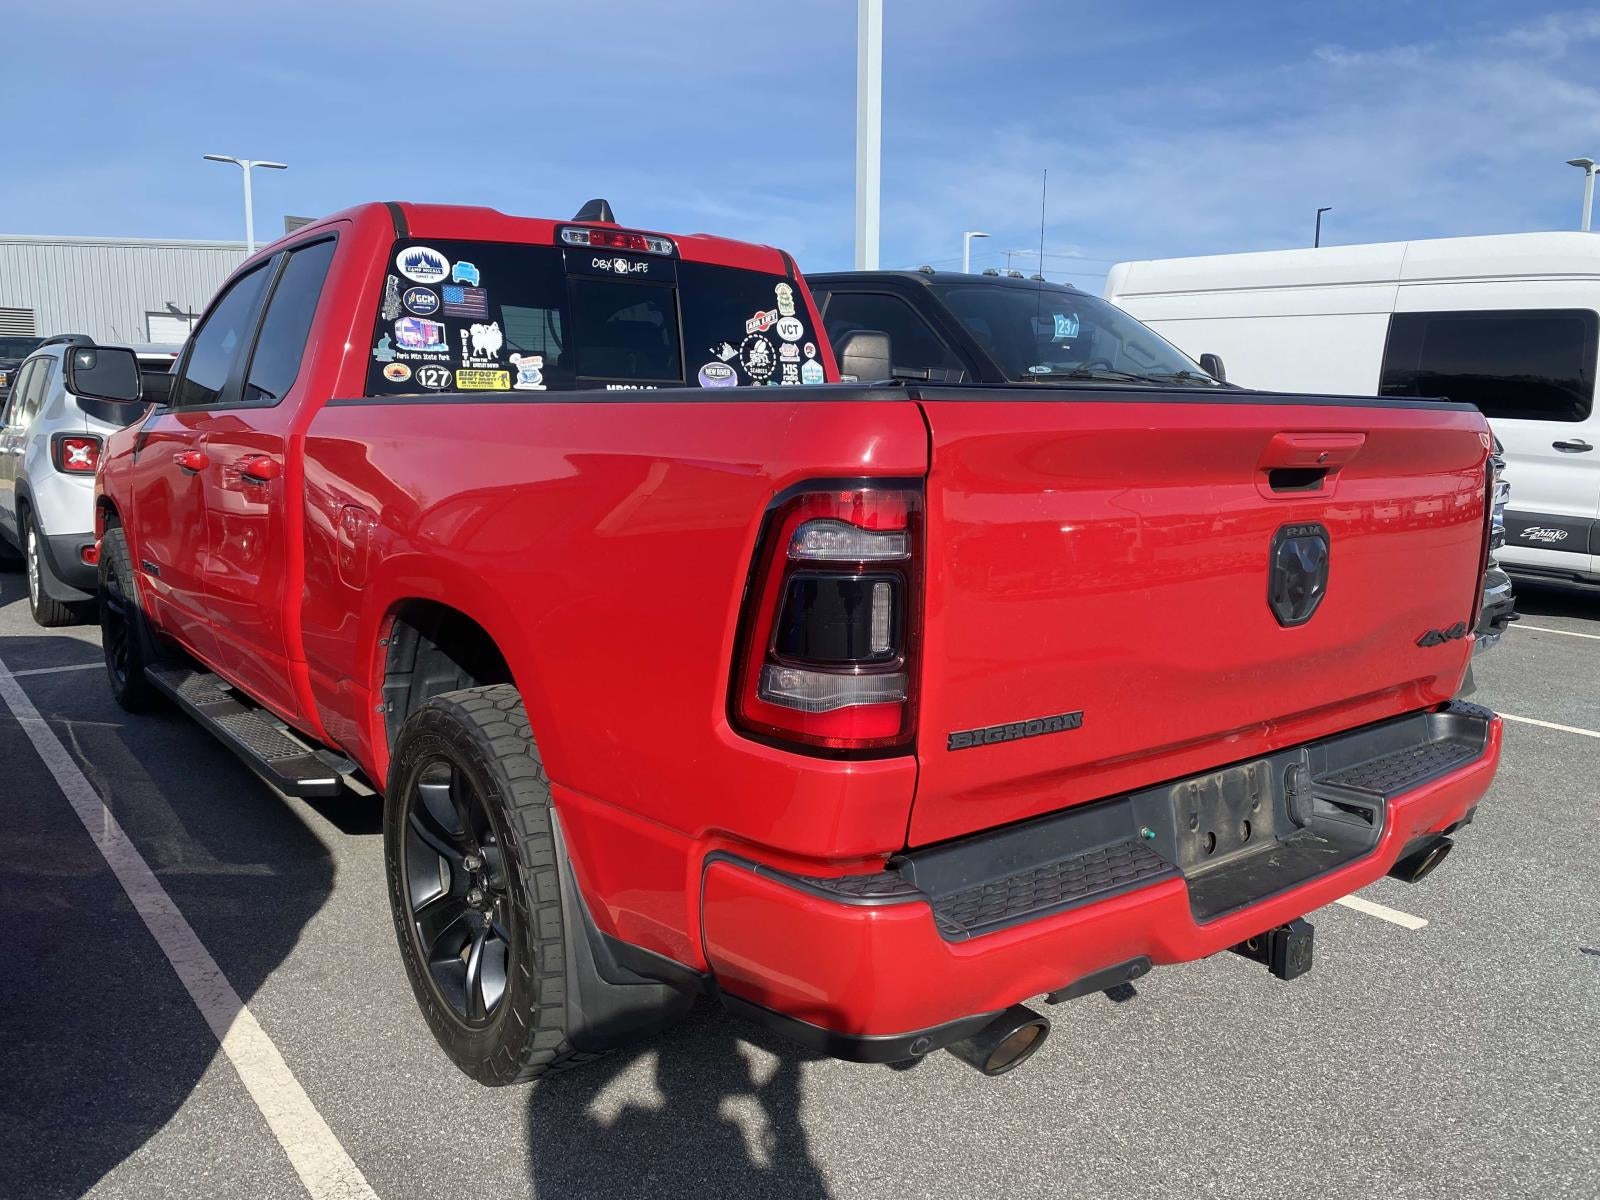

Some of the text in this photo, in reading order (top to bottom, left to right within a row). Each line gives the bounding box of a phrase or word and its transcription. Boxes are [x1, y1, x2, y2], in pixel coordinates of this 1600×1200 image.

[627, 261, 649, 273] LIFE
[416, 294, 435, 304] GCM
[780, 324, 799, 335] VCT
[423, 353, 437, 361] State
[438, 353, 450, 361] Park
[458, 370, 498, 378] BIGFOOT
[705, 368, 731, 377] NEW RIVER
[782, 363, 798, 375] HIS
[418, 369, 449, 387] 127
[1286, 525, 1321, 537] RAM
[947, 710, 1084, 752] BIGHORN
